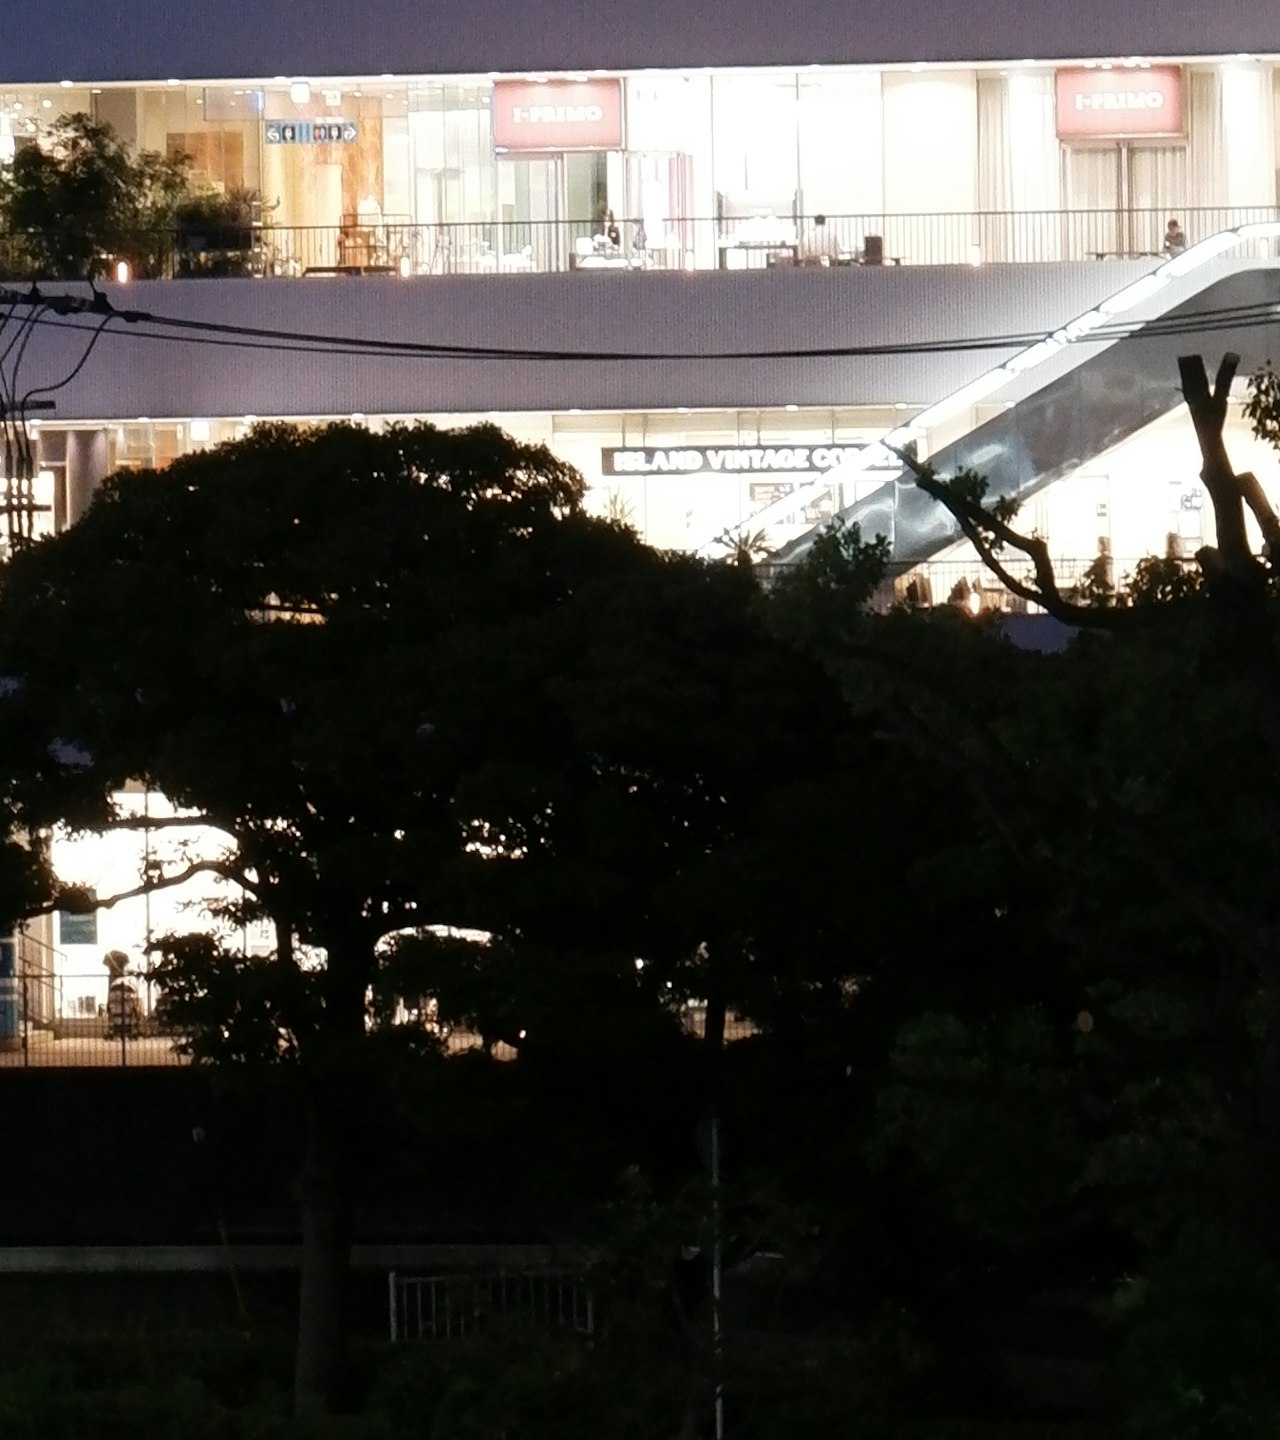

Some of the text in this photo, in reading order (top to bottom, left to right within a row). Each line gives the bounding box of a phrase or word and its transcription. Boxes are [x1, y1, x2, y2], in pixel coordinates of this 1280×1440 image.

[1074, 90, 1165, 112] I-PRIMO
[512, 103, 604, 124] I-PRIMO
[612, 449, 704, 473] ISLAND
[704, 448, 810, 472] VINTAGE
